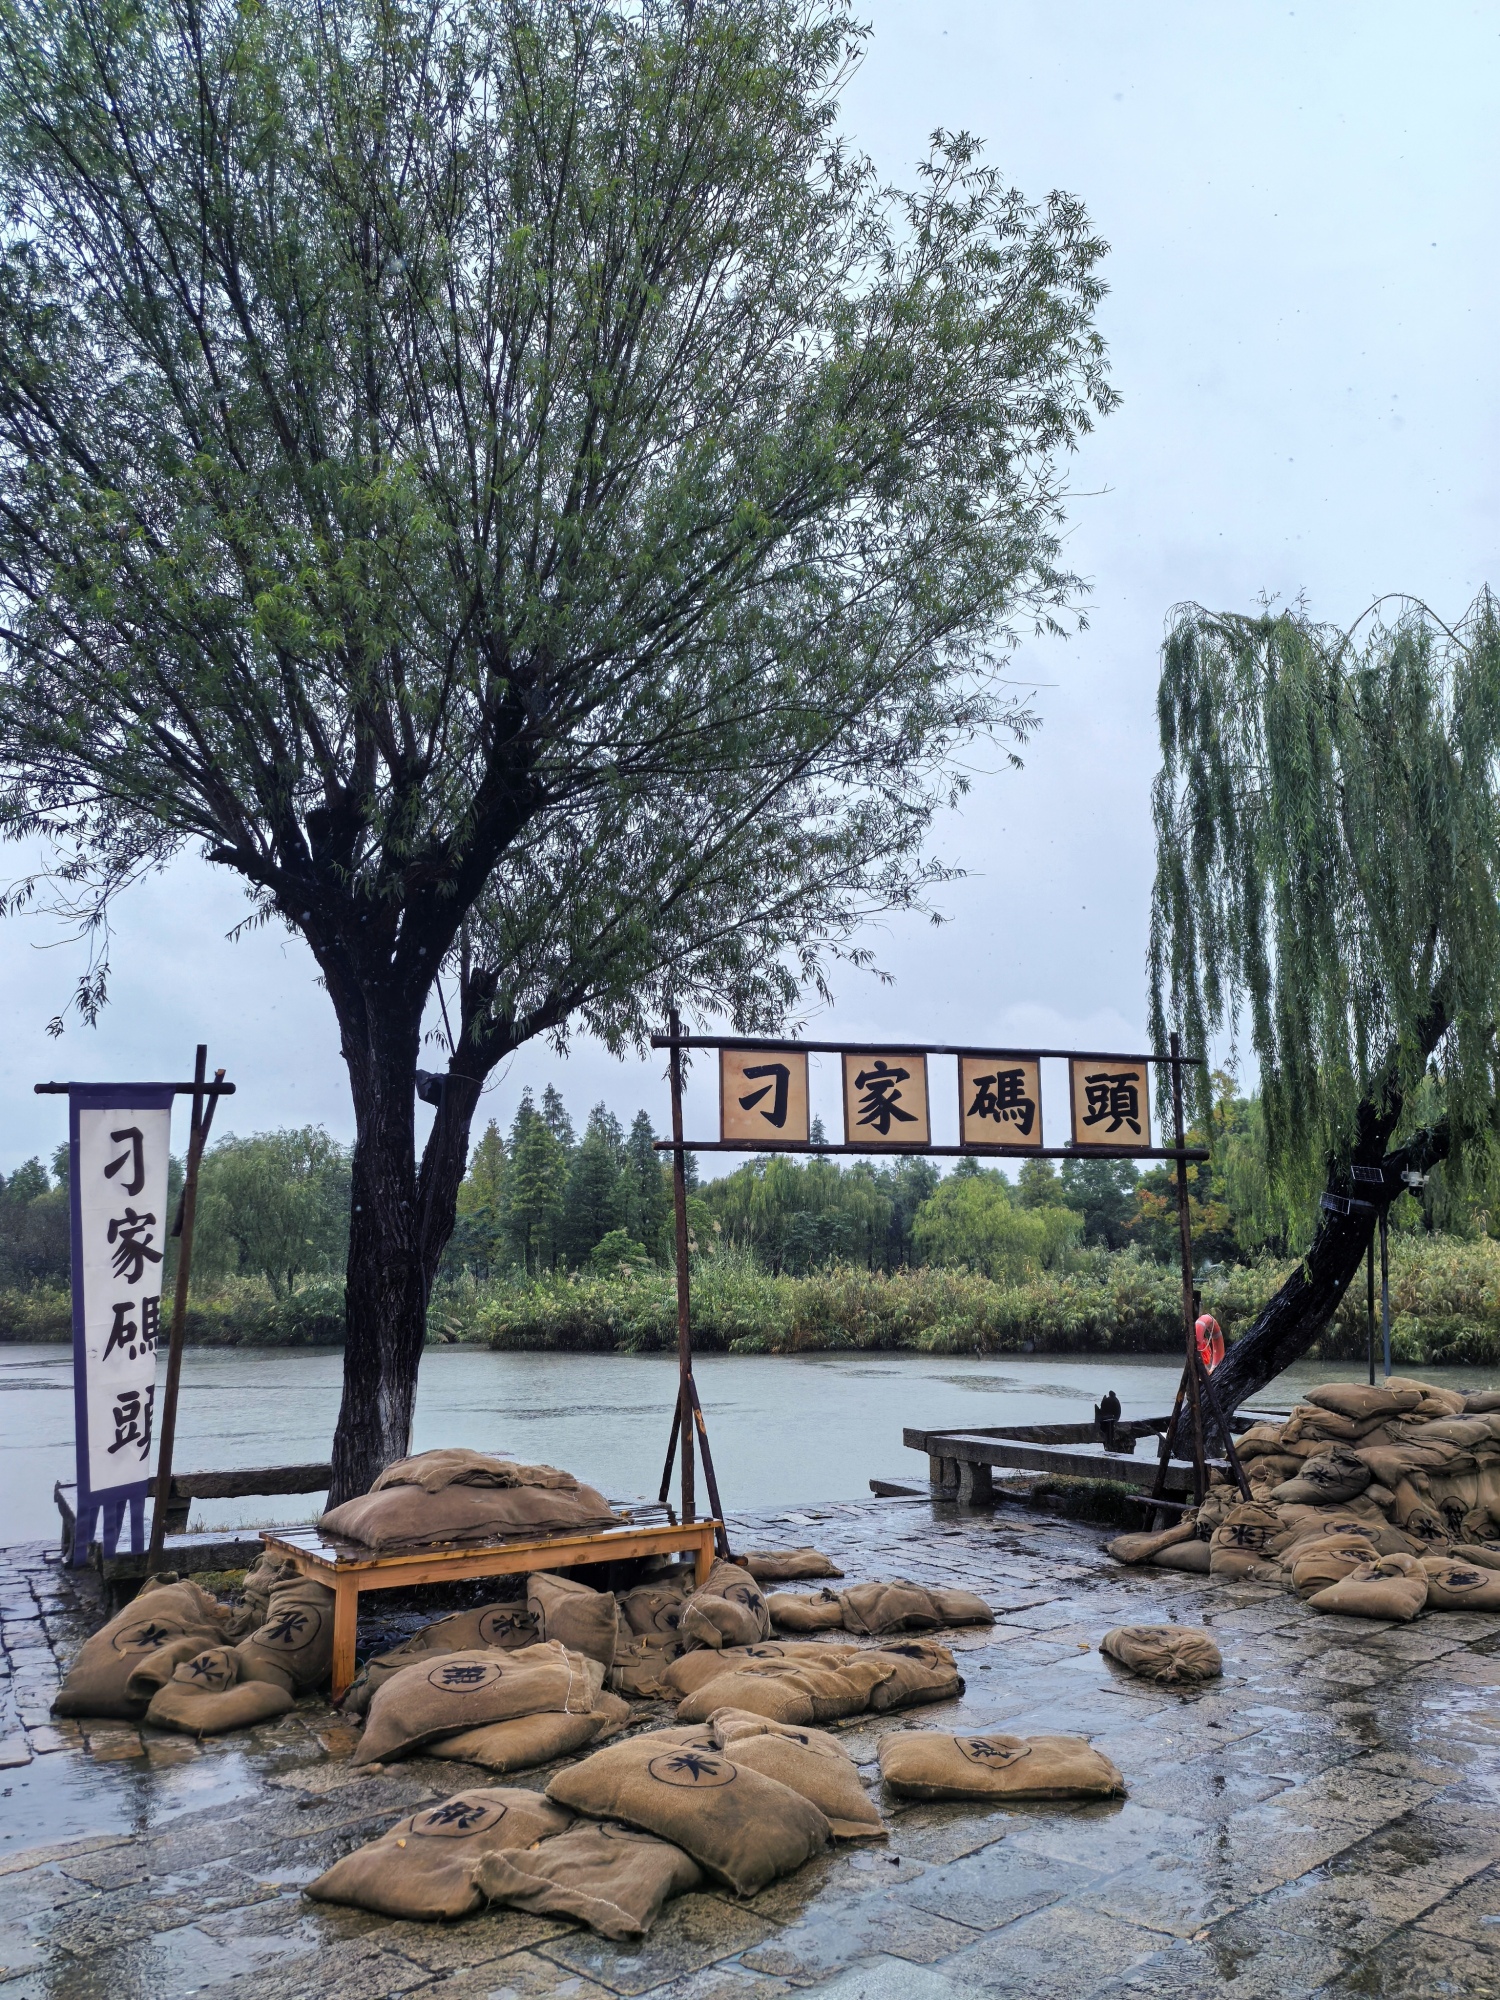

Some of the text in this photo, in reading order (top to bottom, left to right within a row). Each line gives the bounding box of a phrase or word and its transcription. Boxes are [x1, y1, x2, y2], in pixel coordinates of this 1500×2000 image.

[738, 1061, 1141, 1135] 刁家碼頭
[103, 1127, 163, 1462] 刁家碼頭
[665, 1753, 721, 1781] 米
